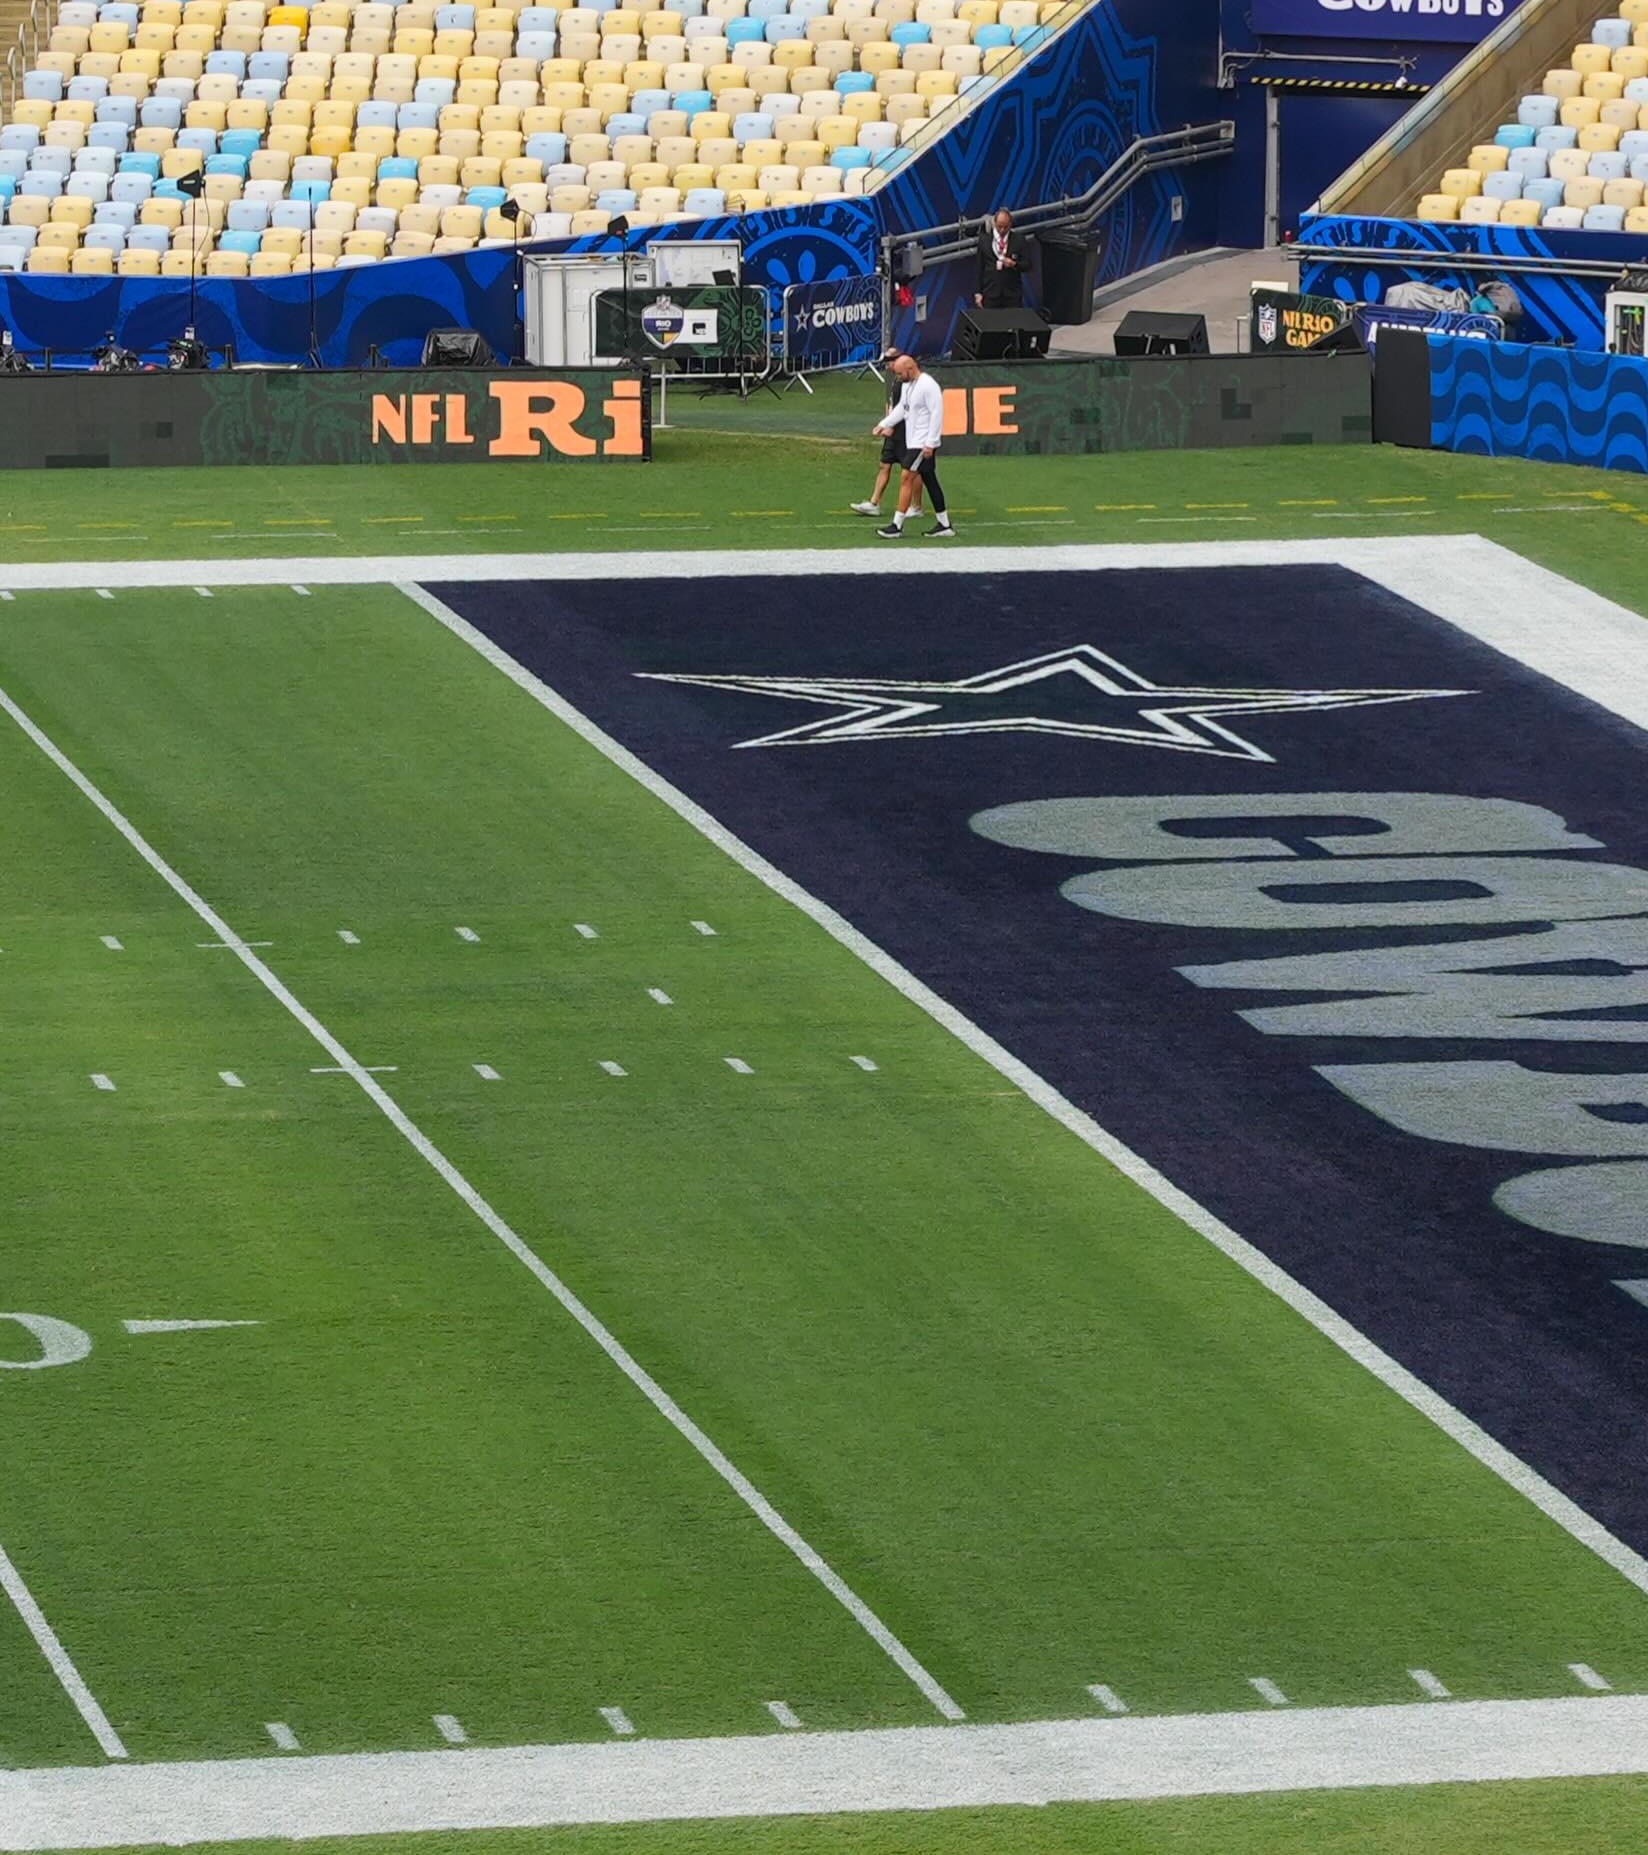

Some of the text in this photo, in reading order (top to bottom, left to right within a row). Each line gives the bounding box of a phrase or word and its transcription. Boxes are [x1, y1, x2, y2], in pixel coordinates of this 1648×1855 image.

[813, 303, 874, 328] COWBOYS
[1286, 329, 1322, 347] GAM
[372, 380, 644, 457] NFL Ri
